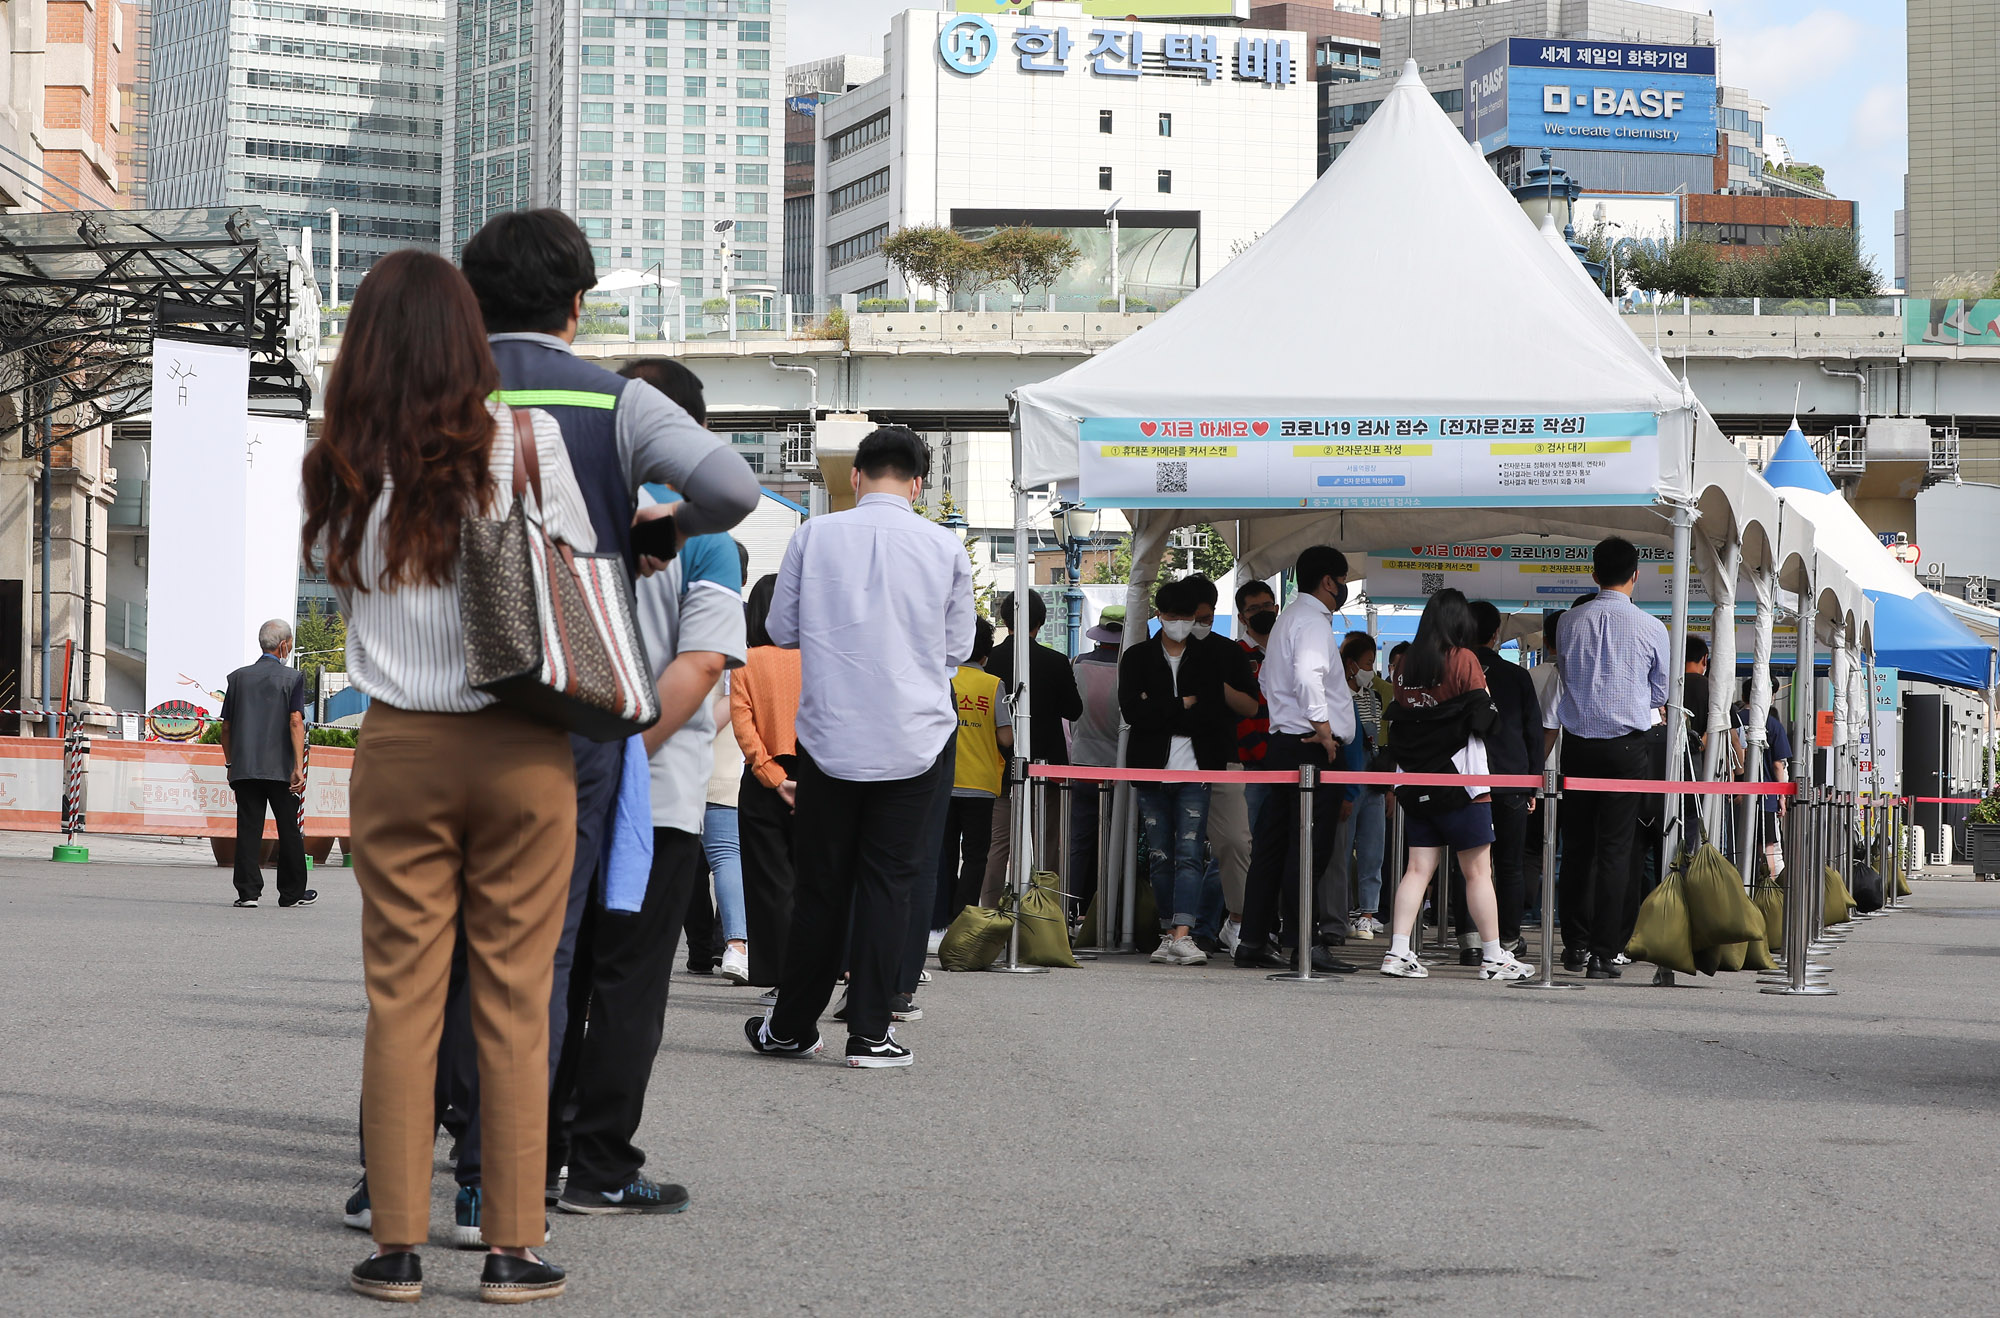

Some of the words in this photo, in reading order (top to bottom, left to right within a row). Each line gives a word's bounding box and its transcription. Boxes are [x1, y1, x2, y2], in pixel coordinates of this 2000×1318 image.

[1015, 25, 1291, 85] 한진택배
[1540, 46, 1570, 63] 세계
[1576, 47, 1622, 66] 제일의
[1627, 50, 1687, 69] 화학기업
[1482, 66, 1504, 98] BASF
[1593, 86, 1685, 118] BASF
[1544, 122, 1565, 135] We
[1569, 125, 1611, 137] create
[1615, 126, 1680, 142] chemistry
[1161, 421, 1193, 437] 지금
[1200, 421, 1249, 438] 하세요
[1280, 420, 1351, 437] 코로나19
[1357, 420, 1390, 436] 검사
[1396, 419, 1428, 436] 접수
[1439, 418, 1535, 436] [전자문진표
[1543, 416, 1586, 434] 작성]
[1122, 446, 1149, 456] 휴대폰
[1151, 446, 1187, 456] 카메라를
[1189, 446, 1207, 456] 켜서
[1209, 446, 1228, 456] 스캔
[1336, 445, 1381, 455] 전자문진표
[1384, 444, 1402, 455] 작성
[1547, 443, 1565, 453] 검사
[1568, 442, 1586, 452] 대기
[1533, 461, 1556, 469] 정확하게
[1503, 470, 1531, 478] 검사결과는
[1313, 498, 1329, 506] 중구
[1333, 497, 1358, 506] 서울역
[1426, 545, 1449, 556] 지금
[1453, 546, 1488, 558] 하세요
[1510, 547, 1560, 559] 코로나19
[1564, 547, 1588, 559] 검사
[1397, 561, 1417, 569] 휴대폰
[1418, 562, 1443, 570] 카메라를
[1445, 563, 1458, 571] 켜서
[1459, 563, 1473, 571] 스캔
[1549, 565, 1582, 573] 전자문진표
[959, 693, 990, 716] 소독
